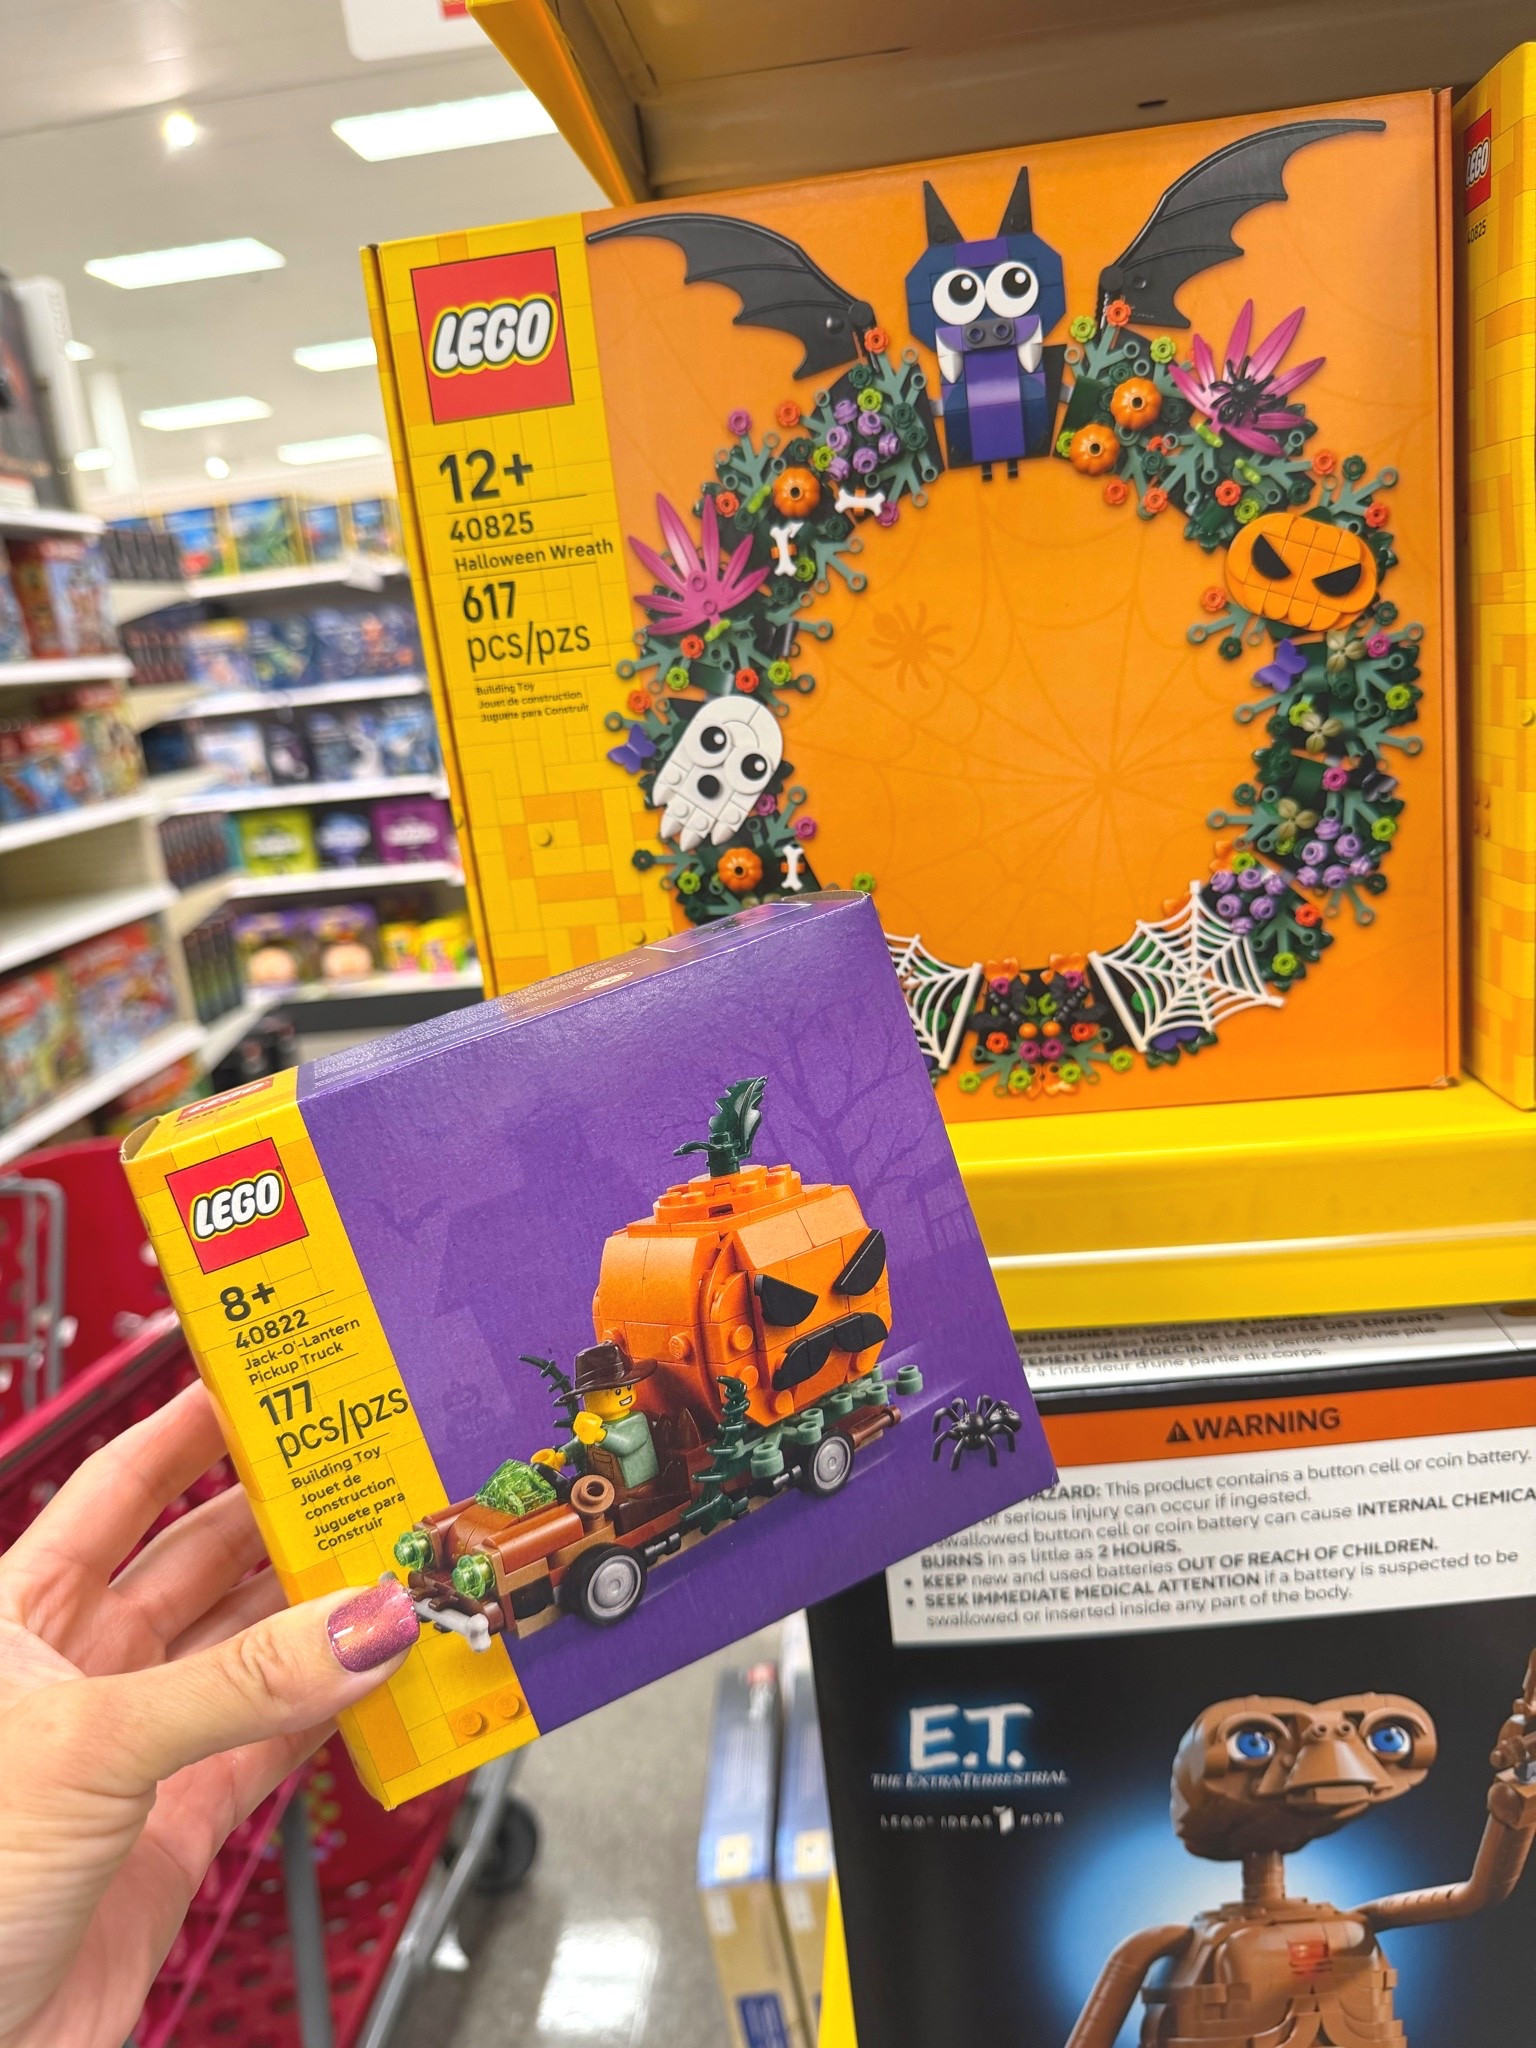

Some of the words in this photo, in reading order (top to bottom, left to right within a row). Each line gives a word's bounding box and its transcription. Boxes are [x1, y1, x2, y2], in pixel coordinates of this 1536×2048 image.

[1465, 138, 1490, 188] LEGO
[1467, 219, 1486, 244] 40825
[431, 296, 557, 376] LEGO
[439, 449, 534, 504] 12+
[450, 511, 534, 543] 40825
[454, 549, 546, 573] Halloween
[550, 539, 614, 561] Wreath
[463, 581, 516, 624] 617
[467, 621, 591, 673] pcs/pzs
[475, 684, 516, 696] Building
[517, 683, 535, 692] Toy
[479, 700, 506, 709] Jouet
[508, 697, 519, 706] de
[522, 691, 582, 704] construction
[481, 712, 519, 723] Juguete
[521, 709, 542, 719] para
[545, 703, 589, 715] Construir
[192, 1171, 284, 1242] LEGO
[220, 1282, 275, 1322] 8+
[236, 1309, 309, 1350] 40822
[244, 1317, 361, 1370] Jack-O'-Lantern
[250, 1358, 299, 1386] Pickup
[301, 1341, 344, 1369] Truck
[1136, 1356, 1183, 1371] d'une
[1189, 1353, 1239, 1369] partie
[1244, 1351, 1267, 1362] du
[259, 1379, 313, 1426] 177
[1193, 1407, 1340, 1440] WARNING
[275, 1387, 409, 1468] pcs/pzs
[291, 1456, 353, 1490] Building
[354, 1445, 382, 1469] Toy
[1029, 1484, 1100, 1502] AZARD:
[1107, 1480, 1139, 1498] This
[1145, 1476, 1213, 1497] product
[1216, 1468, 1289, 1488] contains
[1293, 1470, 1303, 1480] a
[1307, 1464, 1364, 1480] button
[1369, 1458, 1402, 1474] cell
[1404, 1459, 1421, 1470] or
[1426, 1452, 1463, 1469] coin
[1467, 1449, 1532, 1466] battery.
[300, 1482, 341, 1507] Jouet
[343, 1473, 362, 1492] de
[305, 1475, 396, 1521] construction
[1004, 1508, 1067, 1524] serious
[1071, 1503, 1118, 1522] injury
[1124, 1504, 1155, 1517] can
[1161, 1499, 1210, 1513] occur
[1215, 1493, 1226, 1508] if
[1230, 1487, 1312, 1508] ingested.
[313, 1506, 372, 1538] Juguete
[374, 1491, 406, 1513] para
[317, 1516, 384, 1552] Construir
[1033, 1526, 1092, 1543] button
[1096, 1522, 1129, 1539] cell
[1133, 1522, 1151, 1535] or
[1155, 1517, 1192, 1534] coin
[1197, 1513, 1259, 1533] battery
[1264, 1512, 1295, 1525] can
[1301, 1506, 1352, 1522] cause
[1357, 1496, 1447, 1516] INTERNAL
[1451, 1487, 1536, 1508] CHEMICA
[921, 1552, 983, 1569] BURNS
[988, 1552, 1003, 1566] in
[1008, 1553, 1025, 1564] as
[1031, 1547, 1069, 1563] little
[1075, 1548, 1092, 1559] as
[1098, 1544, 1108, 1558] 2
[1112, 1540, 1182, 1557] HOURS.
[923, 1573, 967, 1589] KEEP
[972, 1574, 1008, 1587] new
[1012, 1568, 1045, 1584] and
[1049, 1565, 1092, 1582] used
[1096, 1560, 1173, 1578] batteries
[1177, 1556, 1215, 1572] OUT
[1219, 1553, 1244, 1569] OF
[1248, 1548, 1309, 1566] REACH
[1313, 1546, 1338, 1560] OF
[1343, 1537, 1438, 1558] CHILDREN.
[925, 1593, 968, 1608] SEEK
[972, 1587, 1070, 1606] IMMEDIATE
[1074, 1580, 1154, 1599] MEDICAL
[1158, 1572, 1260, 1594] ATTENTION
[1265, 1569, 1277, 1584] if
[1279, 1572, 1289, 1583] a
[1293, 1564, 1355, 1583] battery
[1361, 1562, 1373, 1576] is
[1379, 1553, 1468, 1576] suspected
[1474, 1553, 1491, 1567] to
[1496, 1550, 1518, 1563] be
[927, 1610, 1018, 1628] swallowed
[1023, 1610, 1041, 1622] or
[1045, 1603, 1115, 1622] inserted
[1120, 1599, 1171, 1617] inside
[1175, 1599, 1205, 1615] any
[1210, 1594, 1245, 1612] part
[1250, 1590, 1267, 1605] of
[1272, 1588, 1299, 1603] the
[1304, 1585, 1352, 1601] body.
[910, 1703, 1033, 1770] E.T.
[871, 1772, 901, 1788] THE
